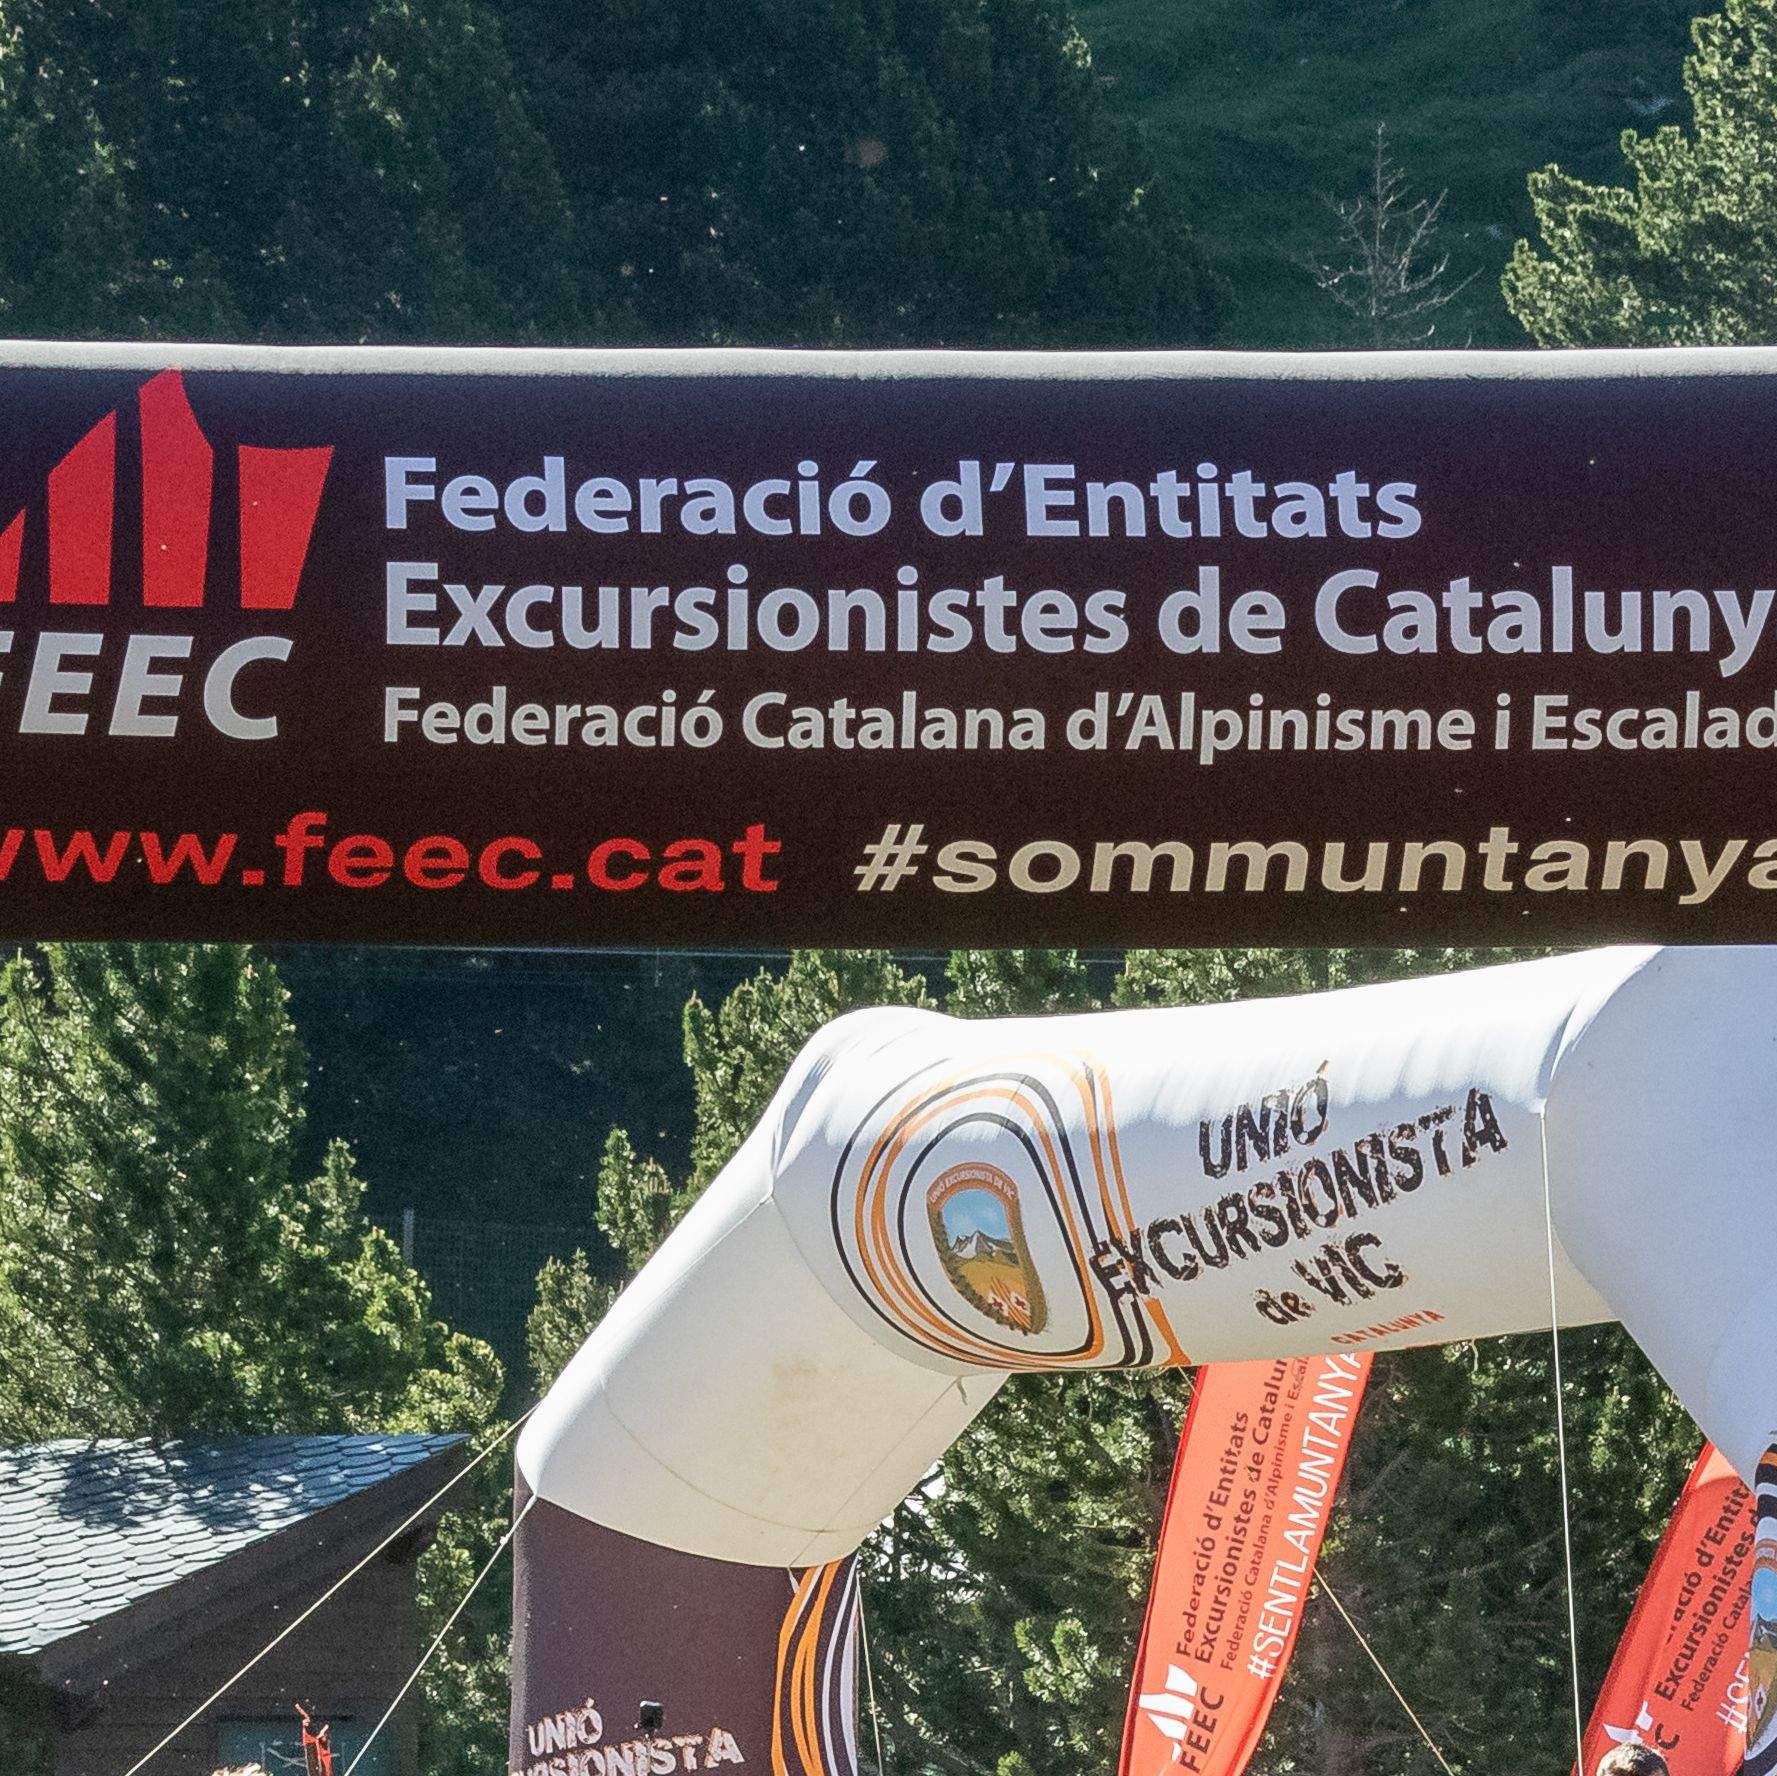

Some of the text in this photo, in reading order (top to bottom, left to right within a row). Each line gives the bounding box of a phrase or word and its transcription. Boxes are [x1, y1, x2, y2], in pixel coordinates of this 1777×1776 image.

[384, 457, 1422, 538] Federació d'Entitats
[384, 562, 1129, 652] Excursionistes
[1158, 566, 1286, 654] de
[383, 686, 722, 748] Federació
[741, 689, 1046, 749] Catalana
[1065, 691, 1475, 765] d'Alpinisme
[1493, 692, 1511, 749] i
[1198, 1059, 1329, 1180] UNIÓ
[1087, 1087, 1510, 1300] EXCURSIONISTA
[1254, 1230, 1409, 1327] de VIC
[1177, 1536, 1216, 1659] Federació
[1196, 1489, 1257, 1664] Excursionistes
[1654, 1530, 1756, 1701] Excursionistes
[1220, 1590, 1253, 1671] Federació
[527, 1697, 603, 1757] UNIÓ
[1180, 1685, 1224, 1774] FEEC
